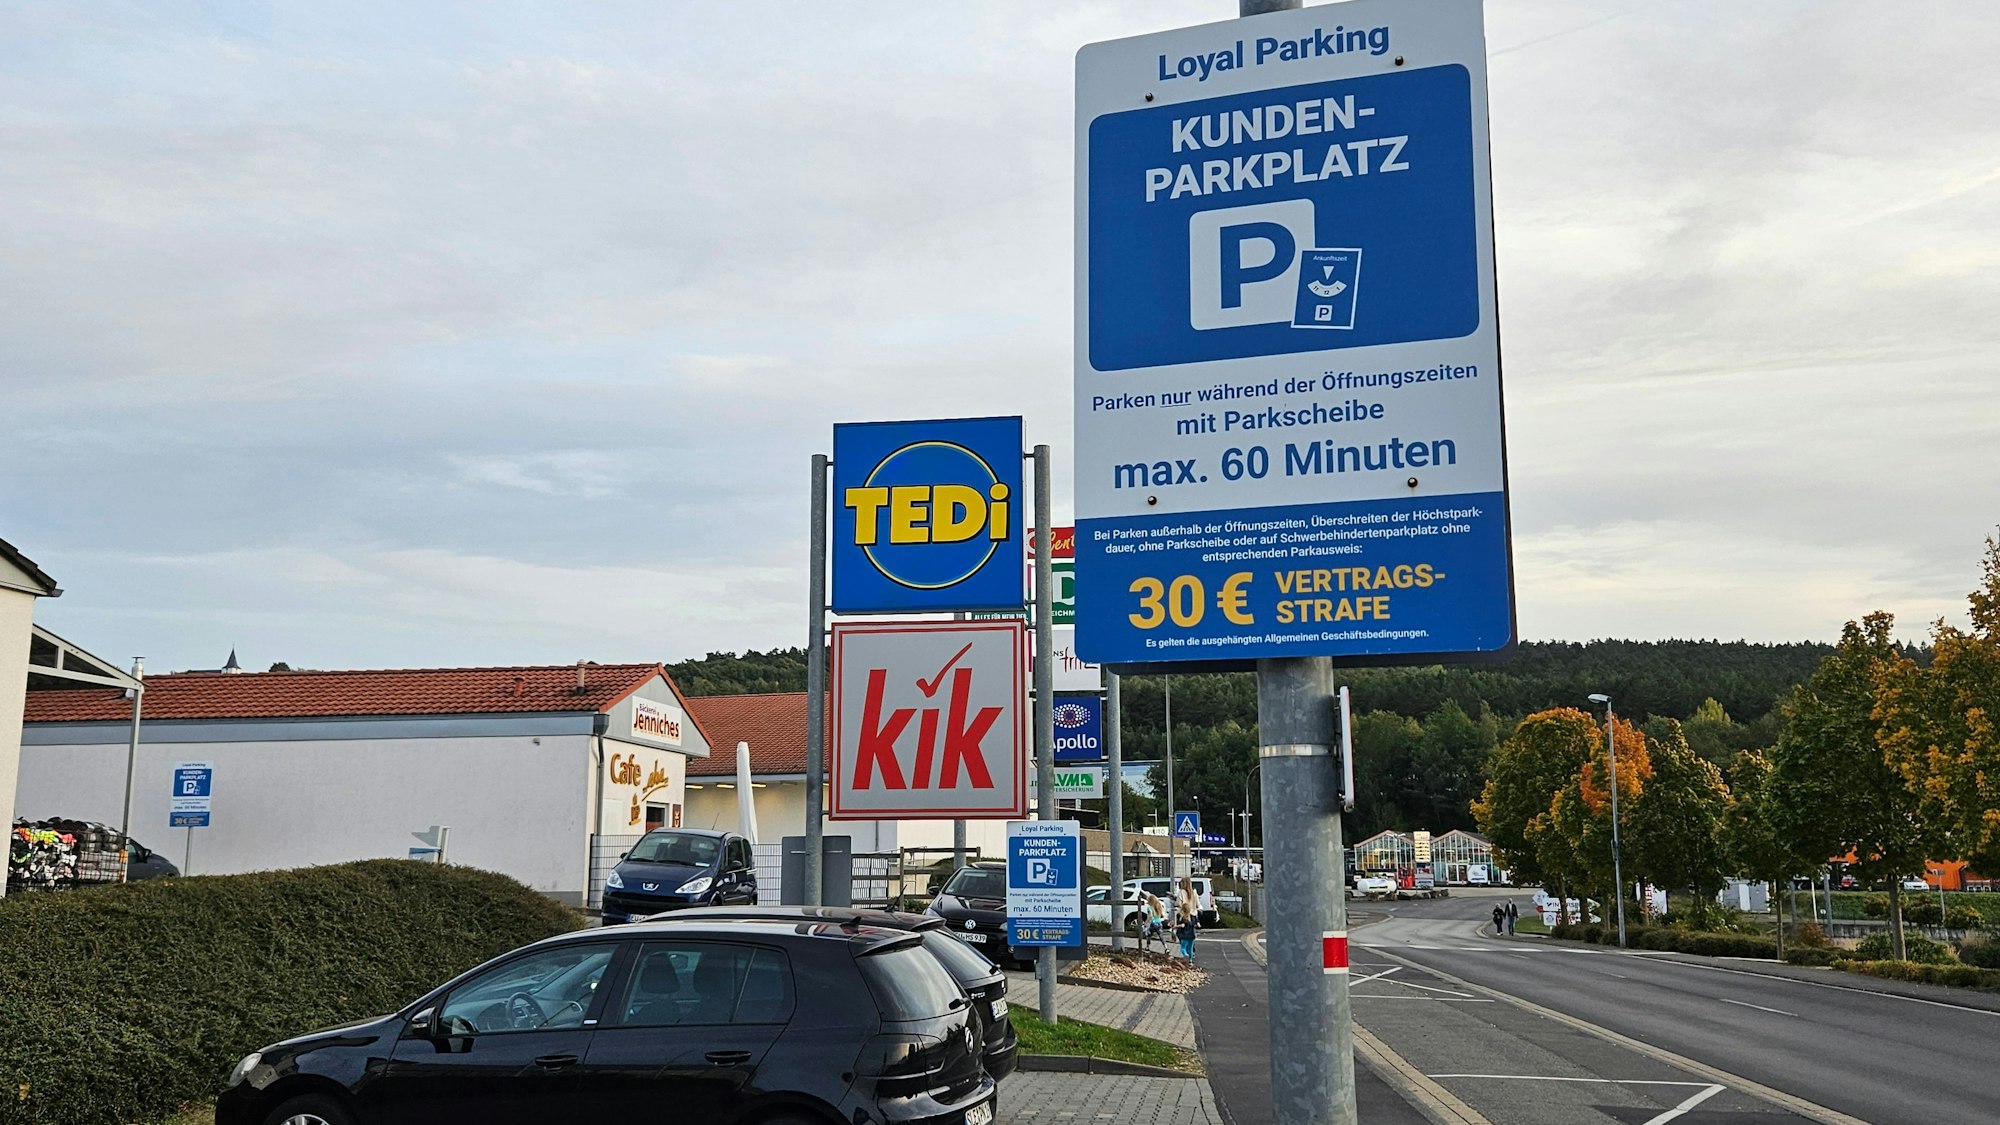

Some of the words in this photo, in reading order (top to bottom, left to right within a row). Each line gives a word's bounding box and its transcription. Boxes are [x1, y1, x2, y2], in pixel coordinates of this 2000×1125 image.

[1159, 40, 1244, 82] Loyal
[1256, 25, 1390, 66] Parking
[1172, 94, 1376, 153] KUNDEN-
[1145, 134, 1410, 203] PARKPLATZ
[1219, 221, 1296, 310] P
[1319, 307, 1330, 318] P
[1092, 393, 1156, 411] Parken
[1160, 390, 1192, 406] nur
[1197, 379, 1278, 402] während
[1285, 377, 1316, 394] der
[1322, 364, 1478, 389] Öffnungszeiten
[1177, 412, 1217, 435] mit
[1224, 399, 1384, 432] Parkscheibe
[1114, 458, 1208, 489] max.
[1221, 445, 1269, 481] 60
[1285, 437, 1456, 476] Minuten
[845, 483, 1011, 545] TEDi
[1094, 530, 1111, 541] Bei
[1113, 528, 1148, 540] Parken
[1150, 524, 1202, 537] außerhalb
[1204, 523, 1222, 534] der
[1224, 518, 1309, 533] Öffnungszeiten,
[1311, 512, 1388, 527] Überschreiten
[1391, 511, 1409, 522] der
[1412, 506, 1483, 522] Höchstpark-
[1105, 542, 1136, 554] dauer,
[1138, 540, 1164, 551] ohne
[1166, 536, 1231, 550] Parkscheibe
[1232, 535, 1258, 546] oder
[1260, 533, 1278, 544] auf
[1280, 525, 1439, 543] Schwerbehindertenparkplatz
[1441, 523, 1471, 534] ohne
[1202, 549, 1288, 563] entsprechenden
[1290, 543, 1363, 557] Parkausweis:
[1274, 563, 1446, 594] VERTRAGS-
[1128, 574, 1205, 630] 30
[1216, 571, 1255, 626] €
[1276, 595, 1391, 624] STRAFE
[1146, 638, 1157, 647] Es
[1158, 637, 1185, 649] gelten
[1186, 636, 1200, 646] die
[1201, 635, 1263, 647] ausgehängten
[1264, 632, 1320, 644] Allgemeinen
[1321, 629, 1429, 641] Geschäftsbedingungen.
[634, 708, 679, 738] Jenniches
[852, 668, 1004, 790] kik
[1053, 734, 1098, 752] pollo
[610, 753, 642, 786] Cafe
[186, 782, 195, 792] P
[1019, 848, 1067, 856] PARKPLATZ
[1024, 839, 1062, 848] KUNDEN-
[1032, 862, 1047, 879] P
[1016, 928, 1031, 940] 30
[1032, 928, 1040, 940] €
